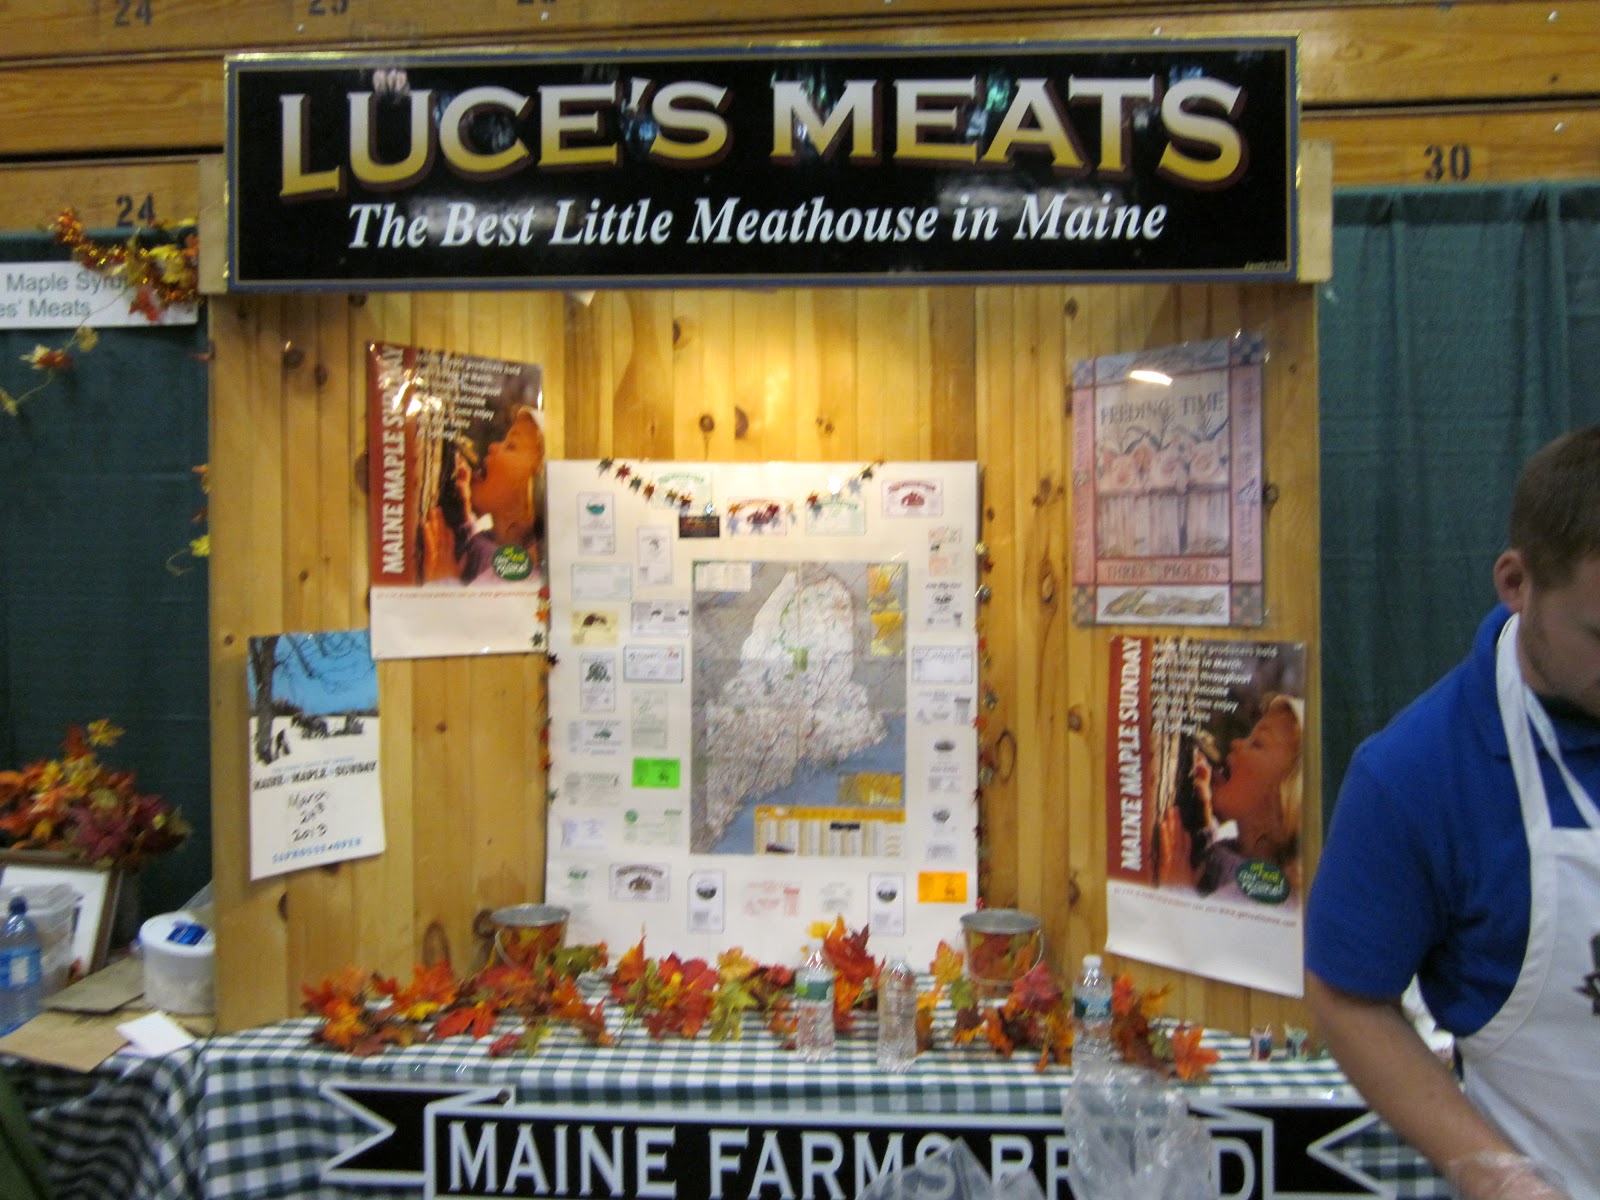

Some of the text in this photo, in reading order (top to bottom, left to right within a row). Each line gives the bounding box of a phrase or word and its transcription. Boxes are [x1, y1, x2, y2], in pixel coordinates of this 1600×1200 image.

[279, 73, 1244, 198] LUCE'S MEATS
[1424, 144, 1471, 181] 30
[116, 193, 154, 227] 24
[347, 192, 1167, 249] The Best Little Meathouse in Maine
[6, 270, 129, 295] Maple Syru
[28, 298, 91, 318] Meats
[382, 430, 405, 501] MAPLE
[382, 503, 405, 574] MAINE
[1118, 637, 1143, 871] MAINE MAPLE SUNDAY
[448, 1120, 677, 1198] MAINE
